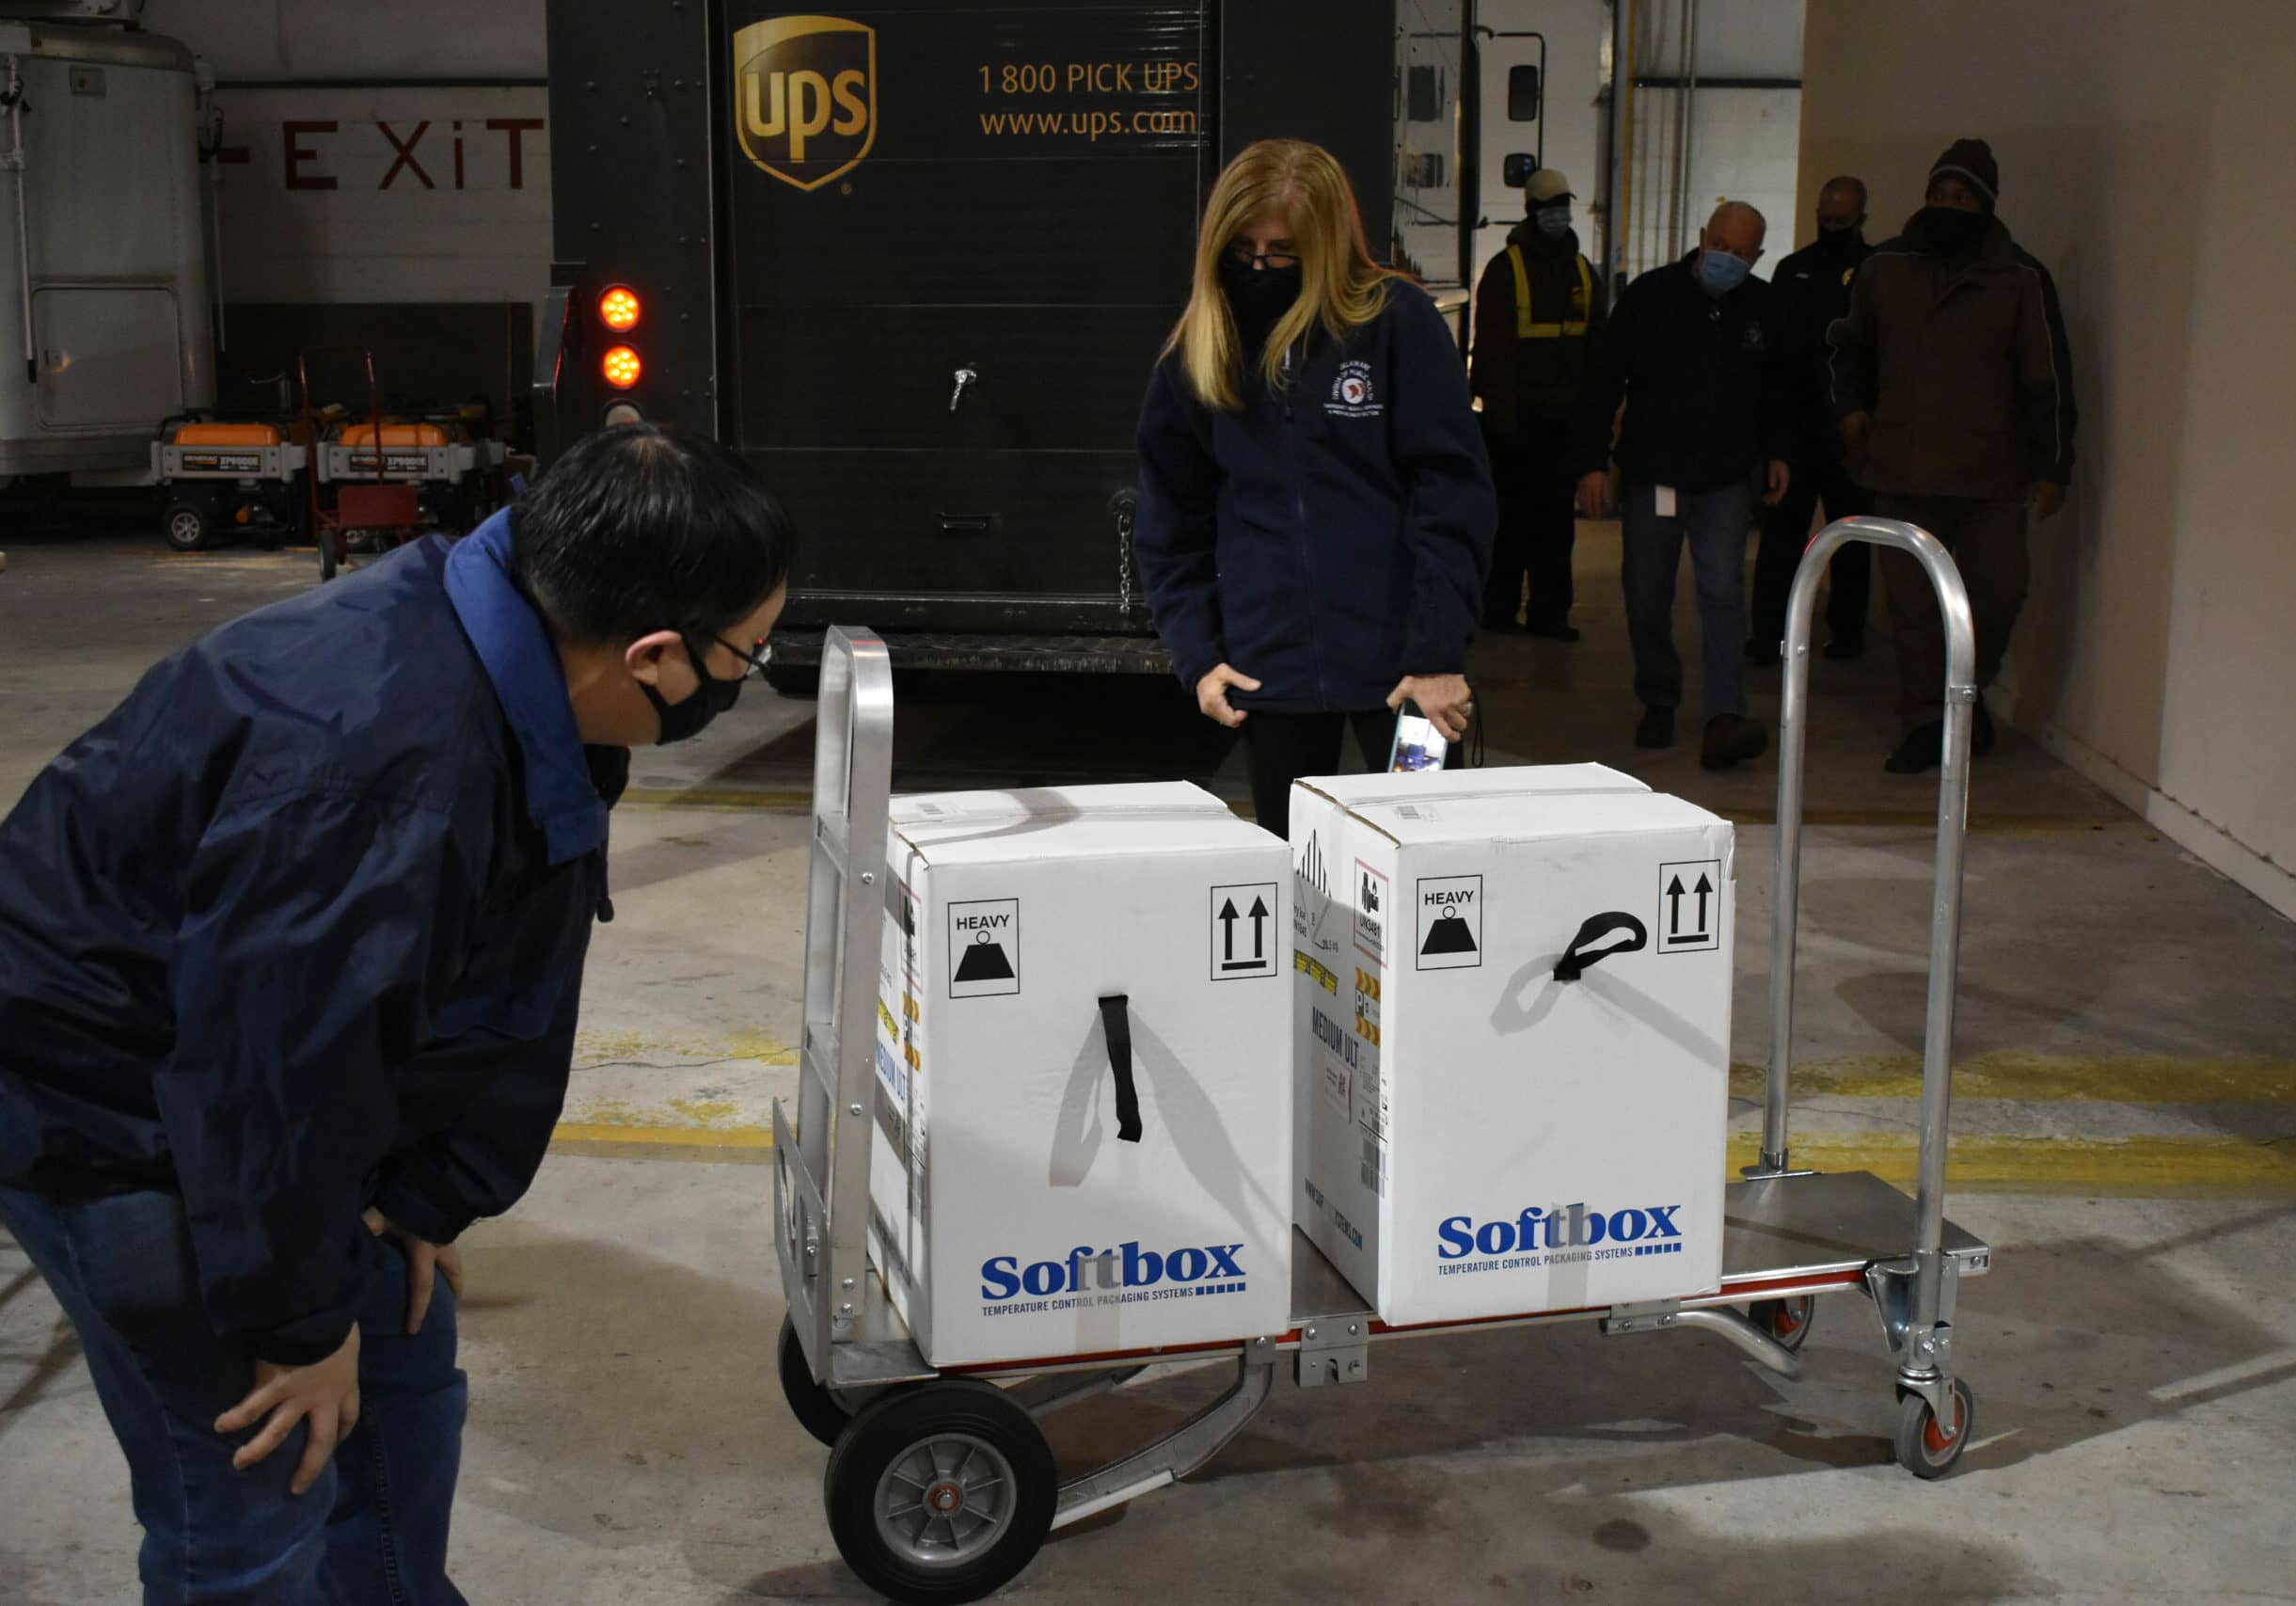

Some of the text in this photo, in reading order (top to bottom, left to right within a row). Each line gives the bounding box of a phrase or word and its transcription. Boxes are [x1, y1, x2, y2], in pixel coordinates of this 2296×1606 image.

[978, 62, 1199, 94] 1 800 PICK UPS
[746, 69, 867, 164] ups
[979, 110, 1198, 142] www.ups.com
[1424, 890, 1475, 906] HEAVY
[957, 914, 1010, 930] HEAVY
[1312, 1006, 1342, 1057] MEDIUM
[1438, 1201, 1682, 1259] Softbox
[981, 1241, 1246, 1300] Softbox
[1438, 1246, 1634, 1276] TEMPERATURE CONTROL PACKAGING SYSTEMS
[982, 1286, 1195, 1316] TEMPERATURE CONTROL PACKAGING SYSTEMS
